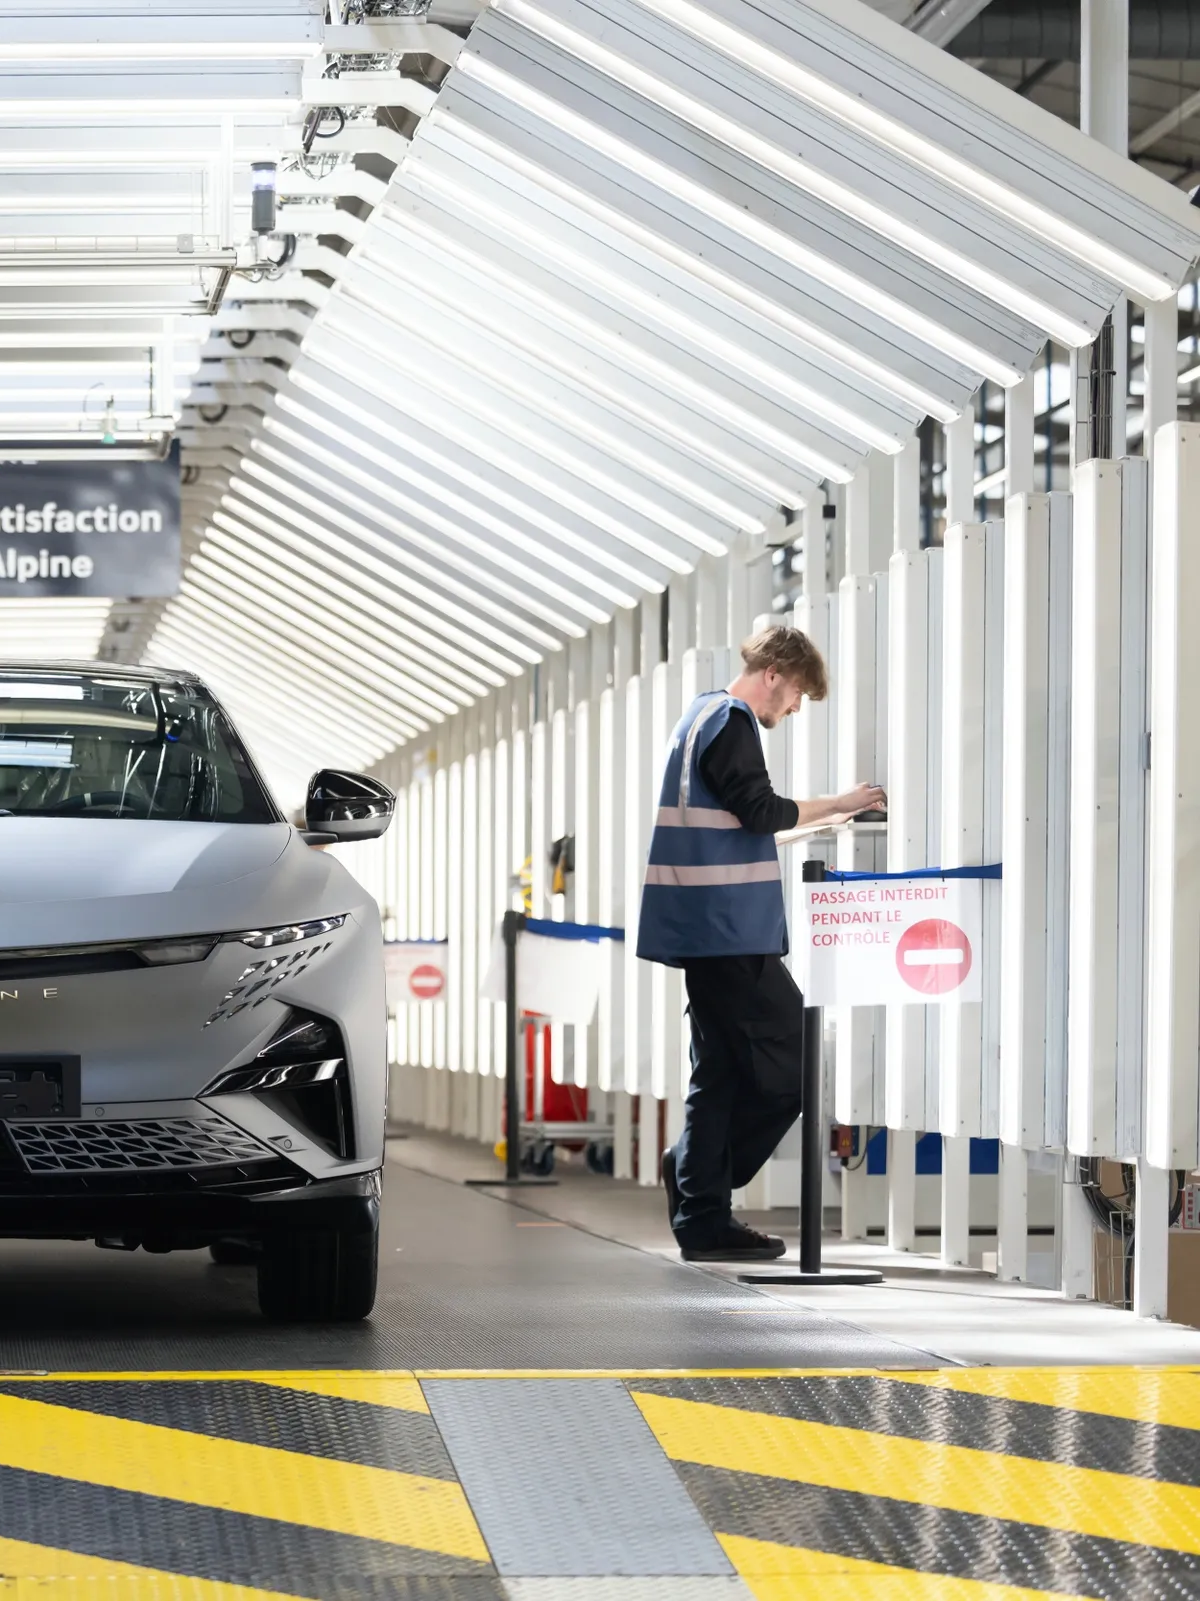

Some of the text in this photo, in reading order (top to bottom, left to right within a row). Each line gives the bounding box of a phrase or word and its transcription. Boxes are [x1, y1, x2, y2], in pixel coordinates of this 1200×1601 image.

[811, 887, 948, 905] PASSAGE INTERDIT
[811, 910, 903, 925] PENDANT LE
[812, 929, 891, 947] CONTRÔLE
